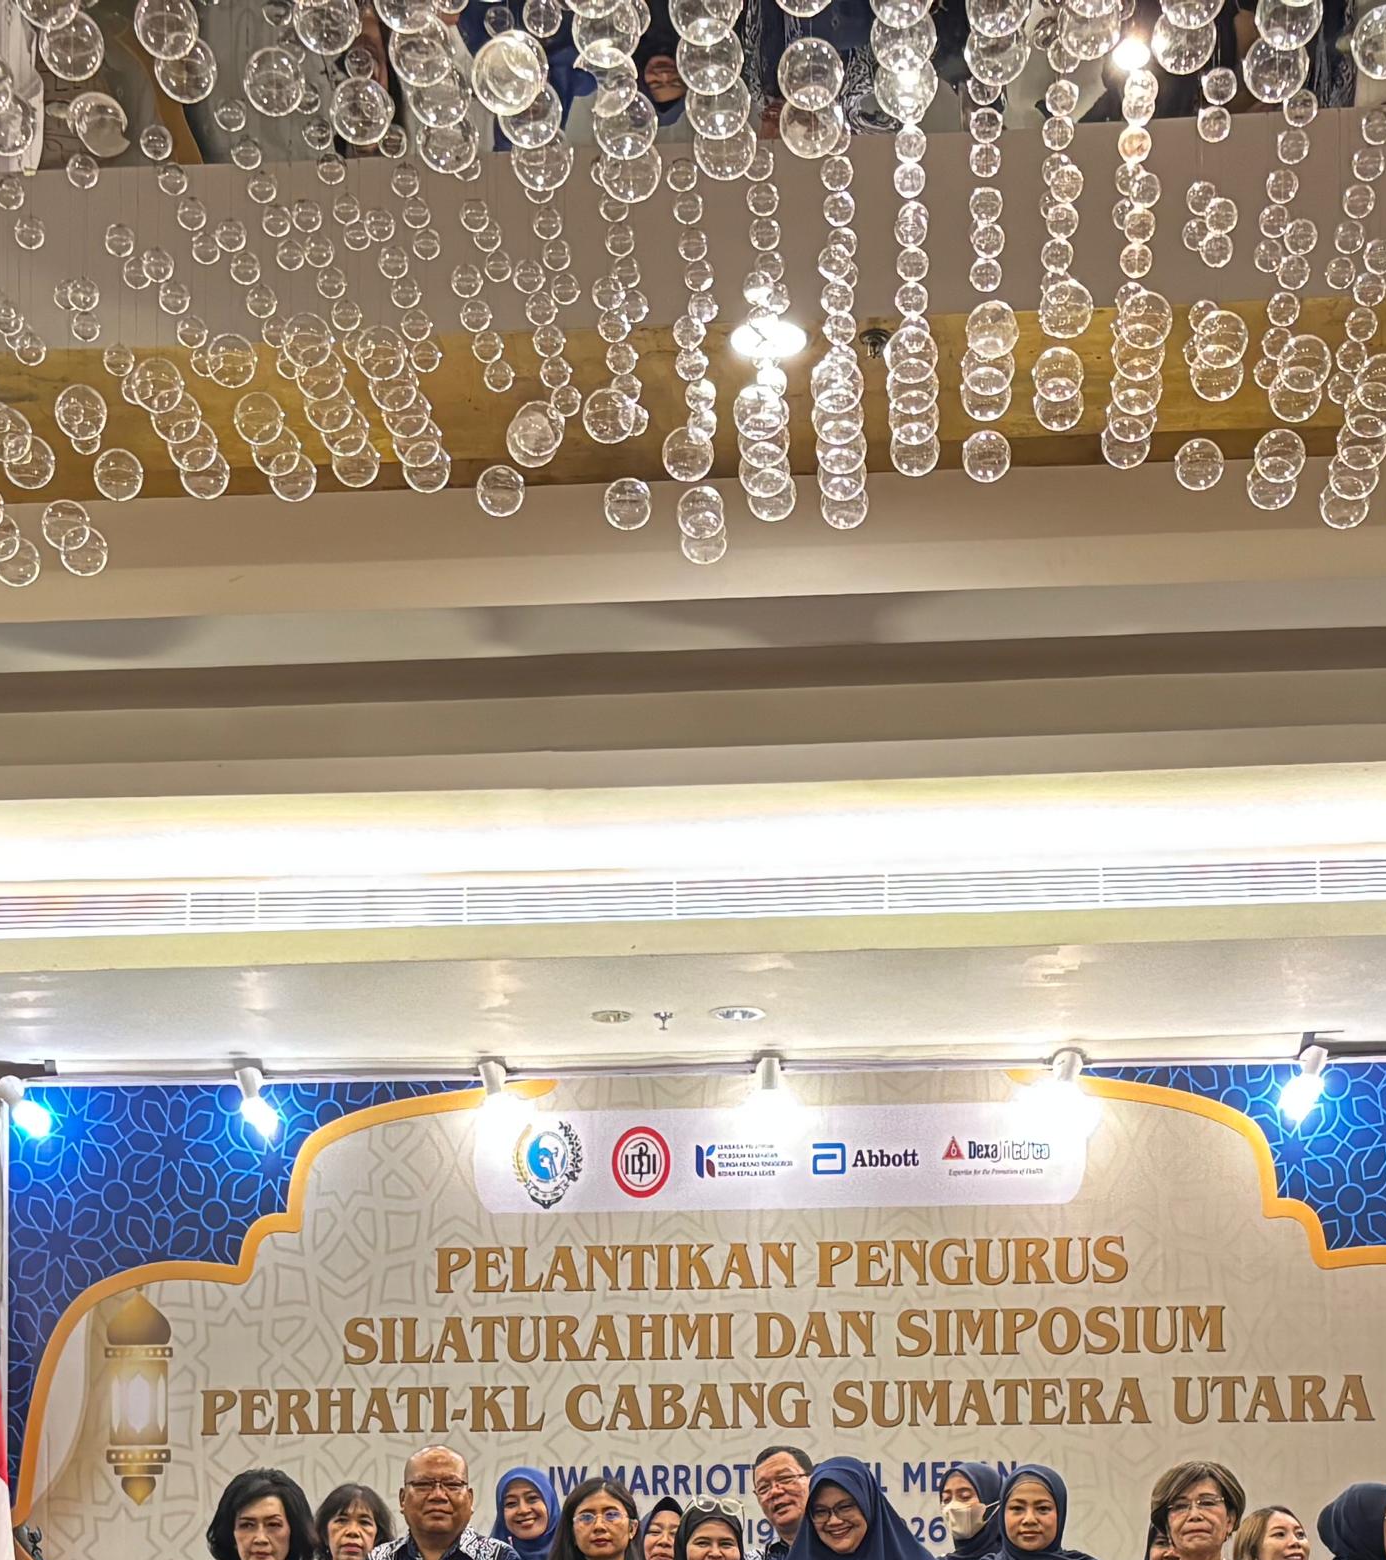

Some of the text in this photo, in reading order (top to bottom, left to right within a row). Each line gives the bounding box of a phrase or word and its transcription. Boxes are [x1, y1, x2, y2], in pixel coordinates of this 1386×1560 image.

[852, 1149, 919, 1168] Abbott
[435, 1236, 1129, 1294] PELANTIKAN PENGURUS
[343, 1305, 1226, 1365] SILATURAHMI DAN SIMPOSIUM
[201, 1374, 1376, 1436] PERHATI-KL CABANG SUMATERA UTARA
[602, 1464, 754, 1496] MARRIOT
